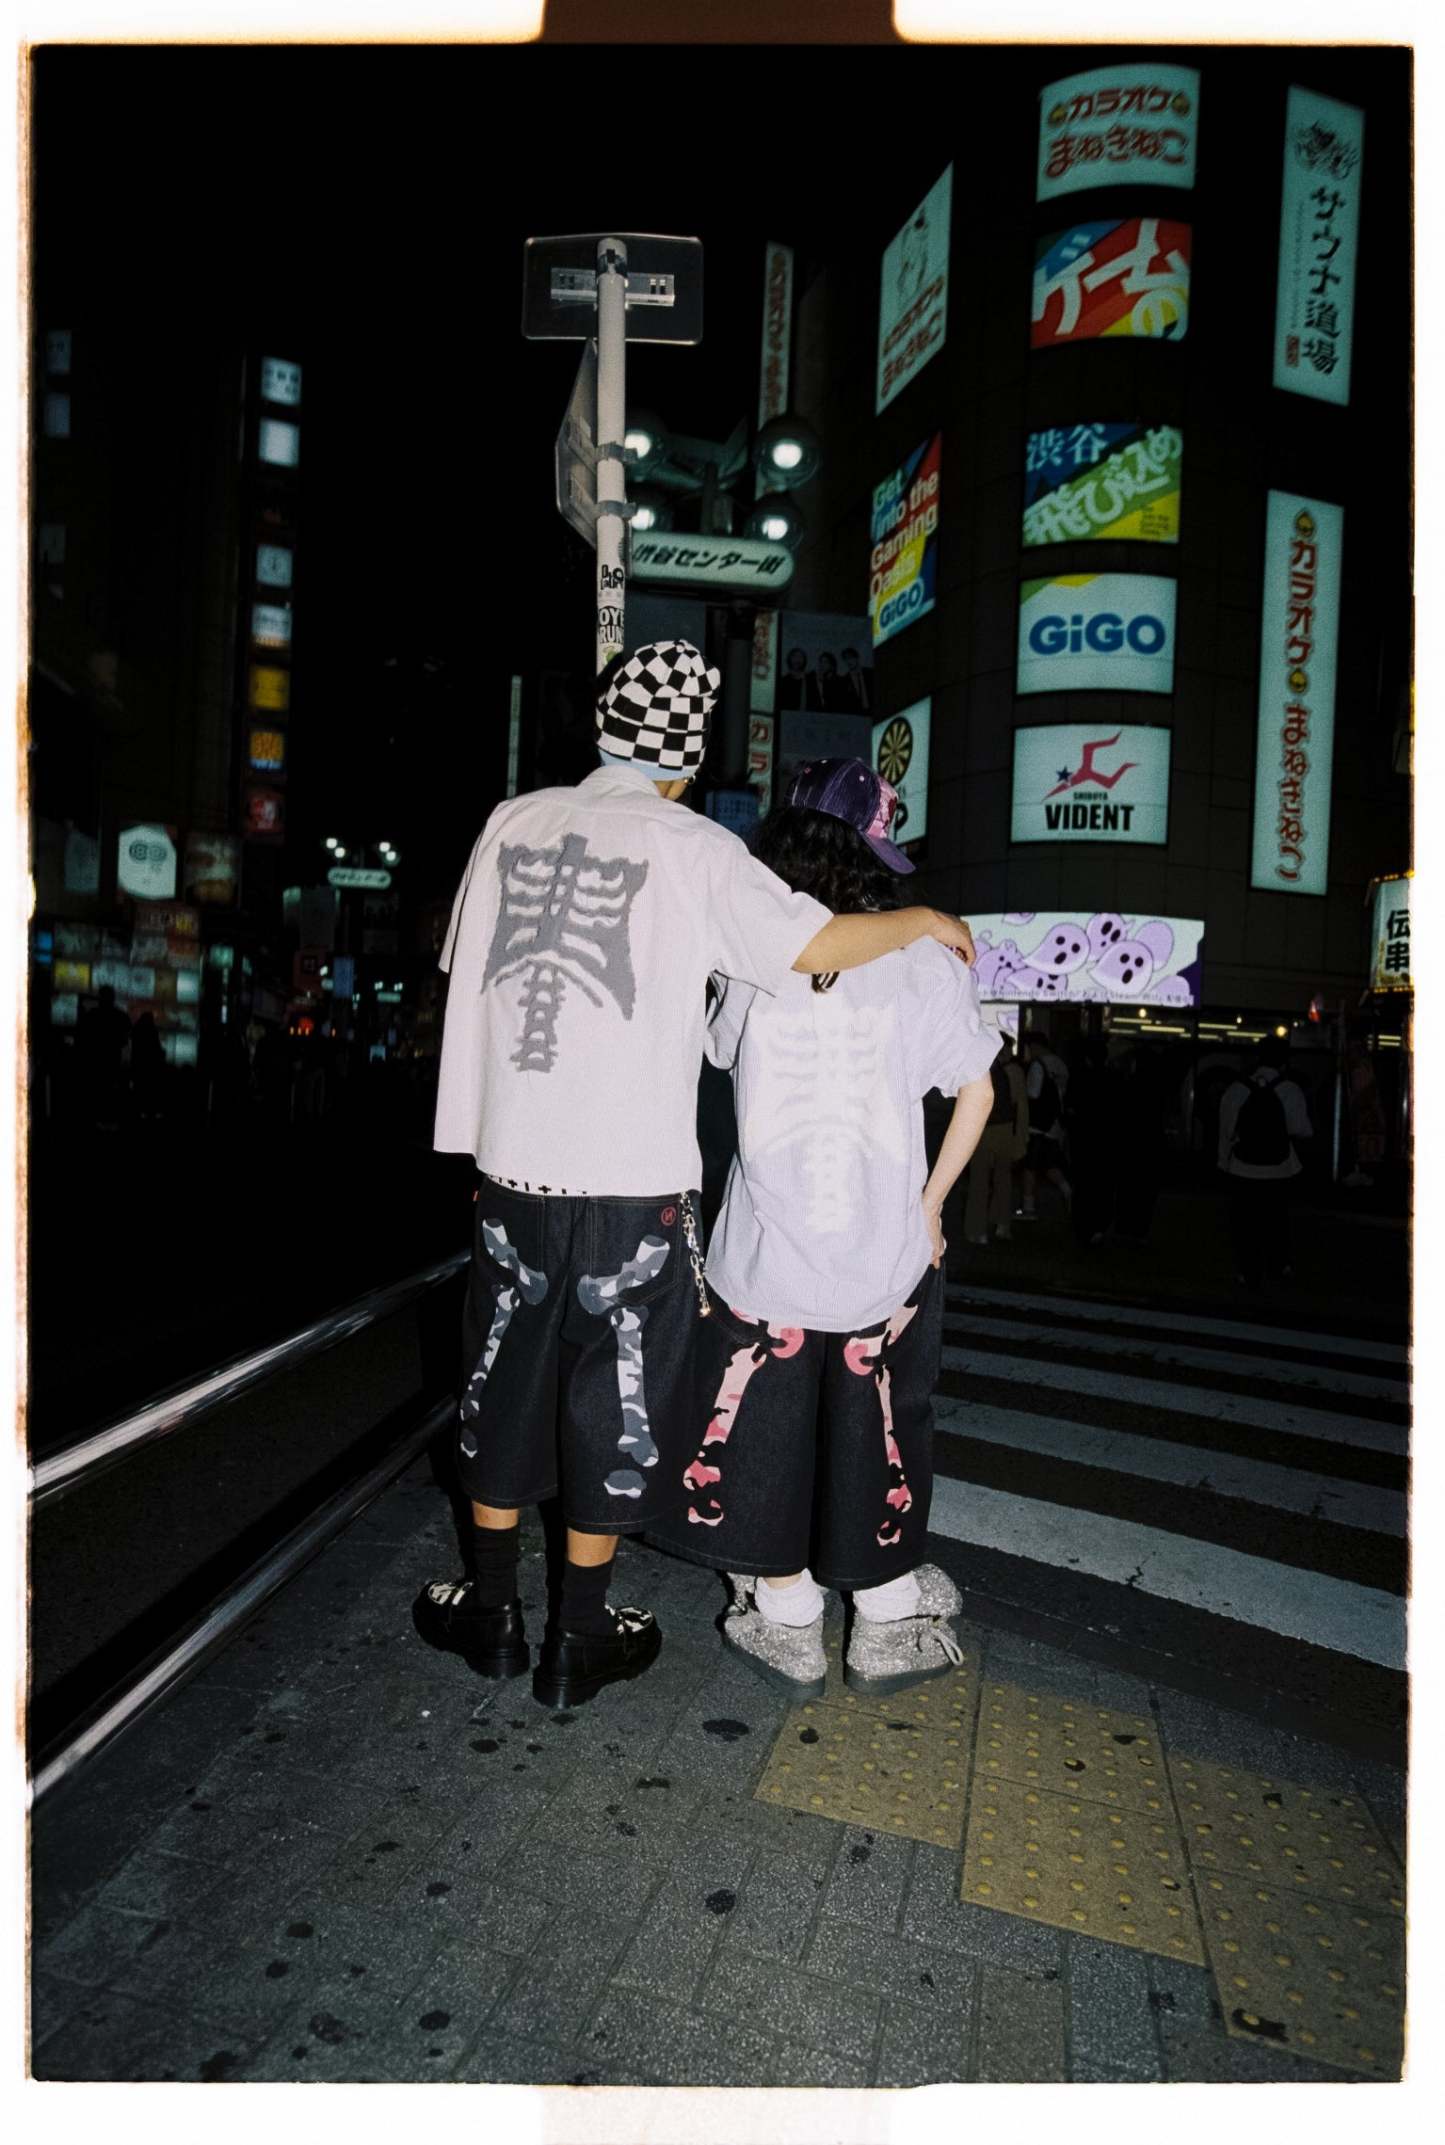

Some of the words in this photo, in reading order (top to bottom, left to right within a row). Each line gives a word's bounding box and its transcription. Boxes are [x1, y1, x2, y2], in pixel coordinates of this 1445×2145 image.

[1068, 86, 1171, 121] カラオケ
[1045, 126, 1188, 178] まねきねこ
[1301, 186, 1345, 375] サウナ道場
[1024, 422, 1110, 473] 渋谷
[870, 499, 907, 542] into
[909, 471, 940, 511] the
[873, 468, 904, 513] Get
[870, 503, 940, 572] Gaming
[879, 582, 921, 628] GiGO
[1287, 540, 1316, 666] カラオケ
[1029, 613, 1166, 655] GiGO
[1278, 703, 1308, 880] まねきねこ
[1045, 804, 1135, 831] VIDENT
